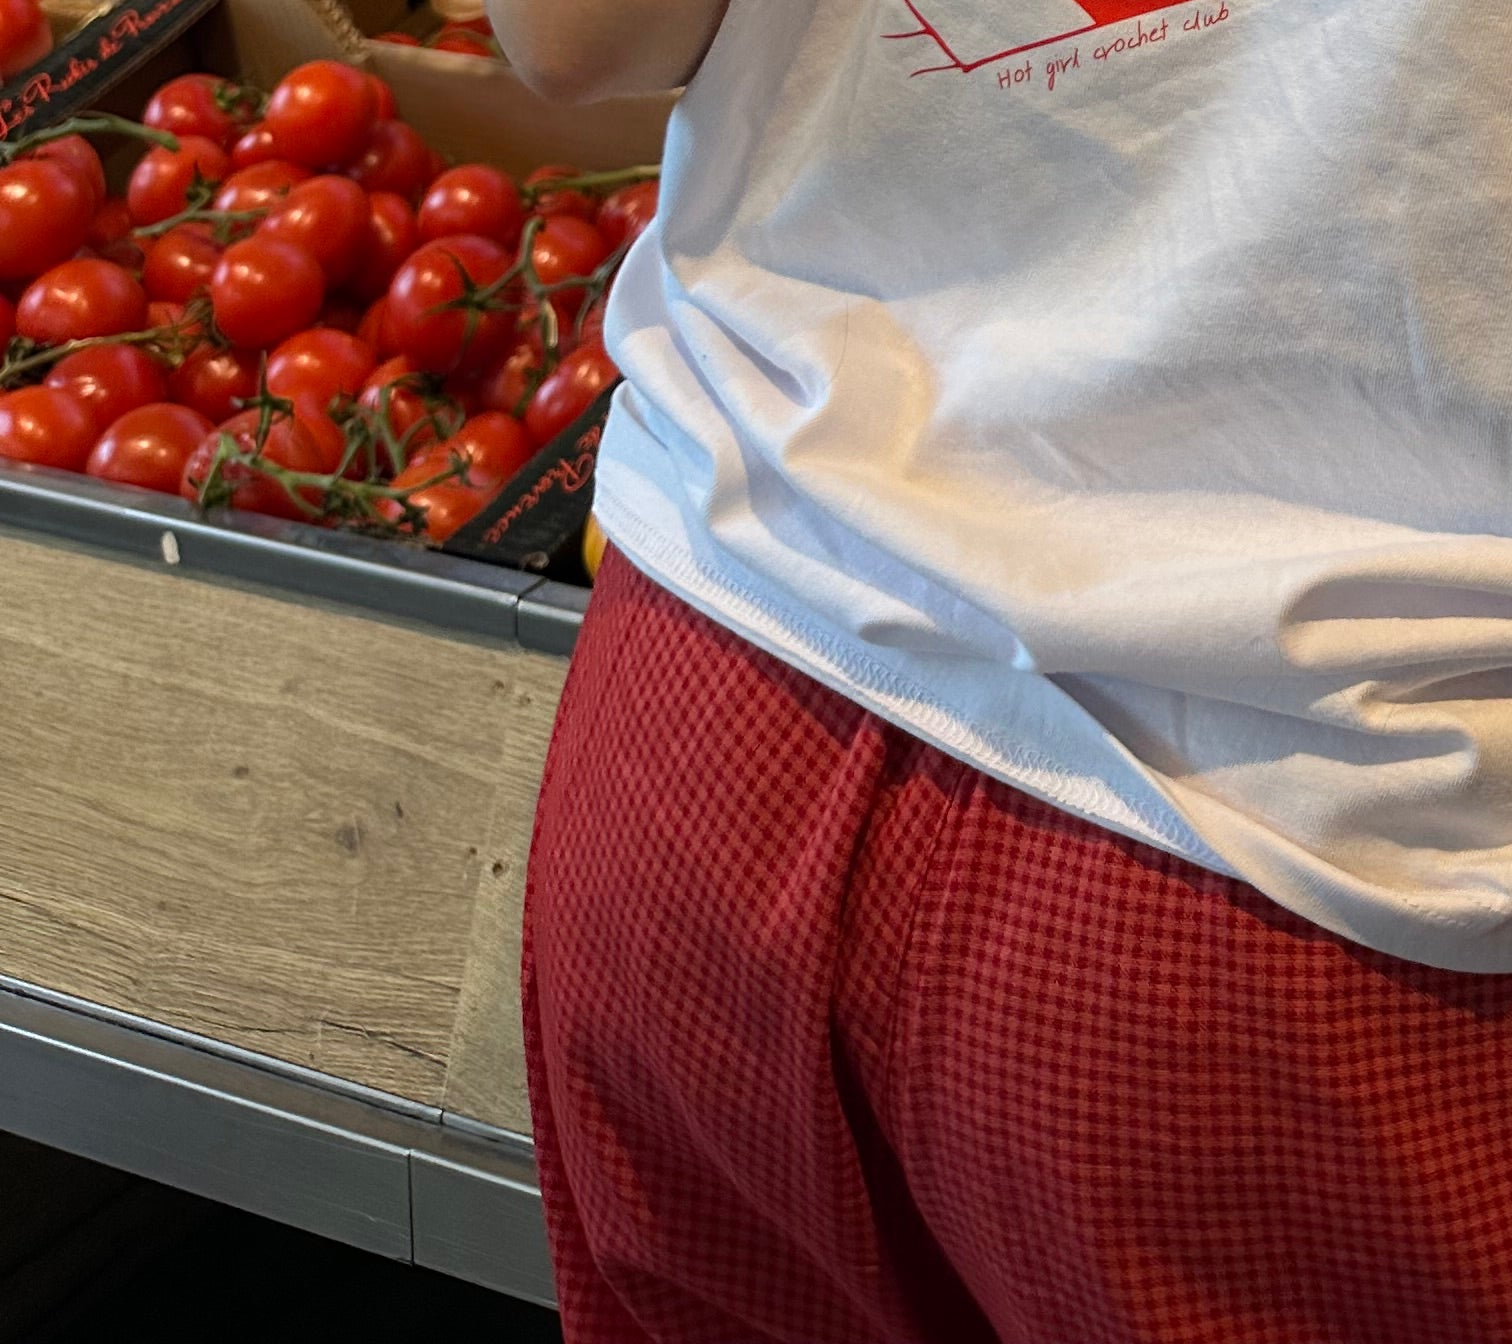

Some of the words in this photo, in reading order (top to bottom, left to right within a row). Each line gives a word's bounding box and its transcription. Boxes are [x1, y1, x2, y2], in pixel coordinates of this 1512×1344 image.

[996, 60, 1033, 90] Hot
[1046, 48, 1081, 91] girl
[1094, 20, 1168, 60] crochet
[1183, 1, 1229, 32] club
